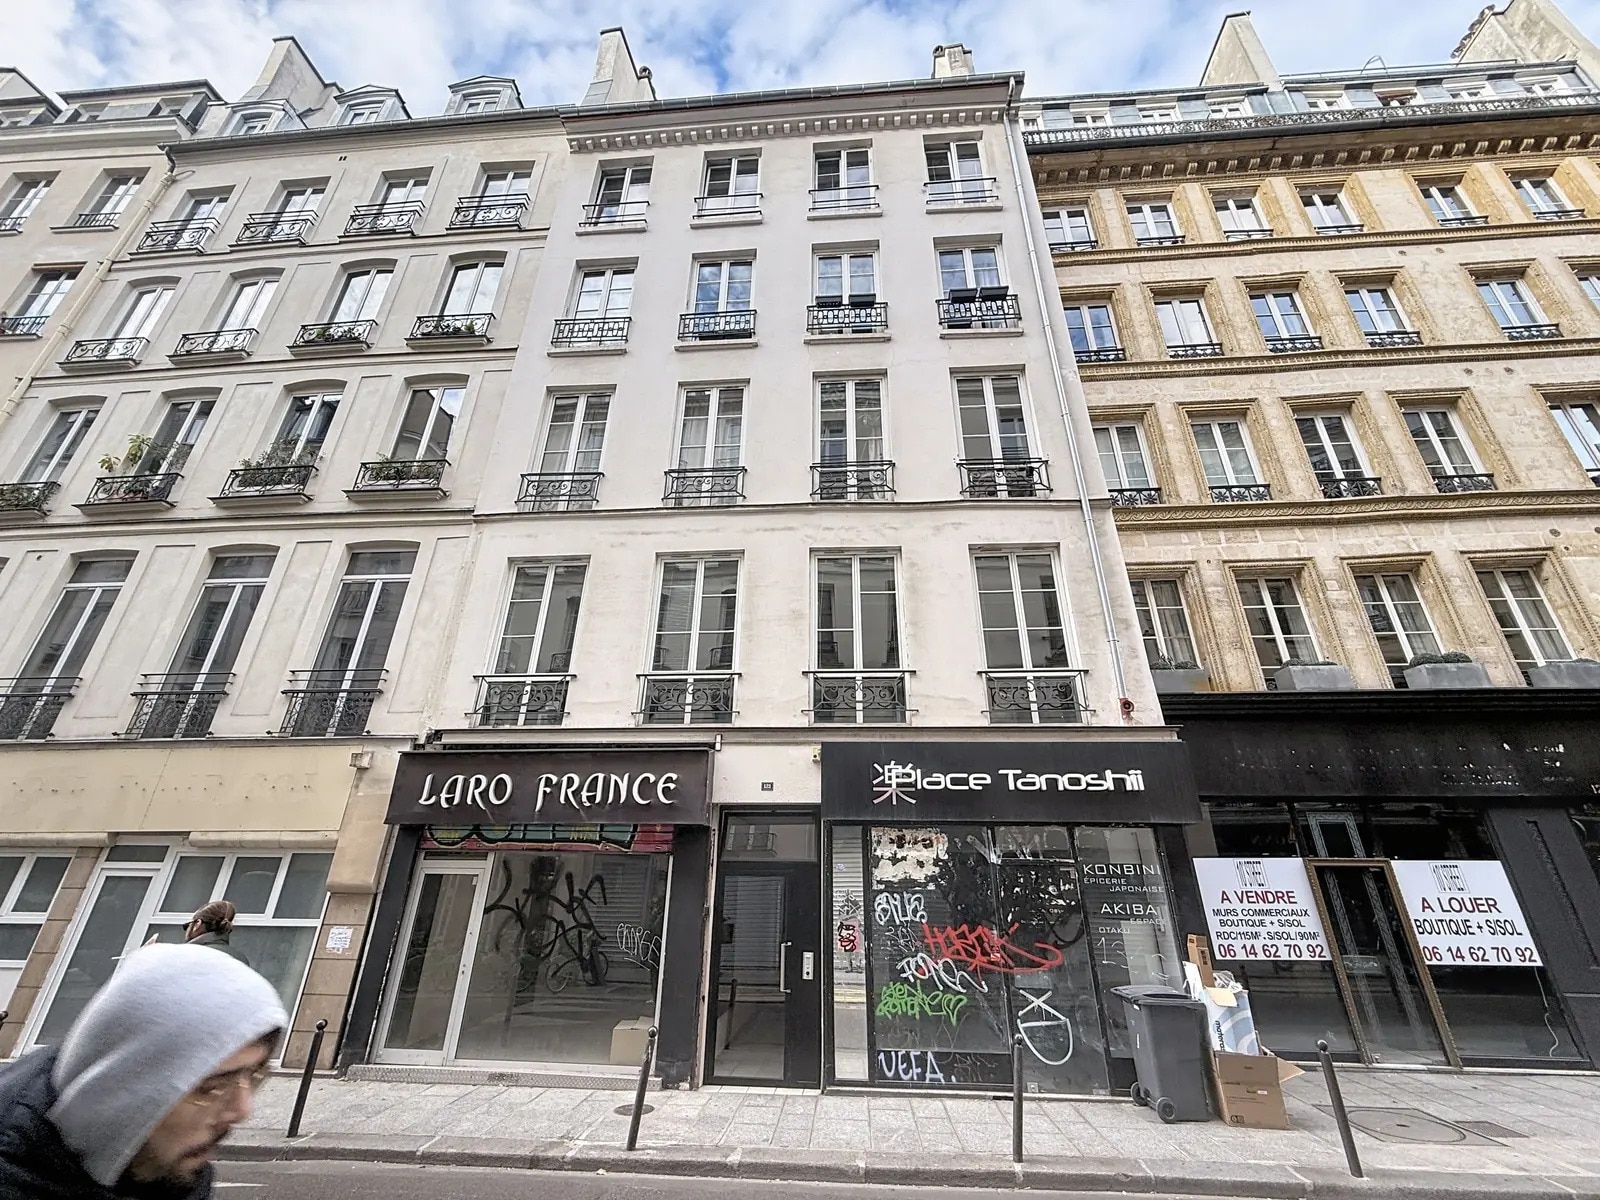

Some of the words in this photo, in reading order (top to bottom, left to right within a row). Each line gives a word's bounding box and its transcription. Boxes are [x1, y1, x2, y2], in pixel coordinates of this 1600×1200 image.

[998, 768, 1145, 791] Tanoshii
[418, 773, 513, 811] LARO
[534, 772, 679, 813] FRANCE
[1083, 864, 1161, 875] KONBINI
[1084, 876, 1127, 885] ÉPICERIE
[1221, 890, 1232, 904] A
[1234, 890, 1298, 905] VENDRE
[1421, 896, 1435, 913] A
[1437, 897, 1503, 914] LOUER
[1100, 903, 1157, 915] AKIBA
[1212, 908, 1239, 917] MURS
[1241, 908, 1310, 918] COMMERCIAUX
[1219, 919, 1267, 928] BOUTIQUE
[1277, 919, 1306, 928] S/SOL
[1413, 918, 1476, 937] BOUTIQUE
[1485, 919, 1524, 936] S/SOL
[1217, 943, 1237, 958] 06
[1241, 943, 1258, 958] 14
[1261, 943, 1281, 959] 62
[1283, 943, 1302, 958] 70
[1306, 943, 1327, 959] 92
[1422, 946, 1443, 962] 06
[1446, 946, 1465, 962] 14
[1468, 946, 1490, 962] 62
[1491, 946, 1512, 963] 70
[1514, 947, 1537, 963] 92
